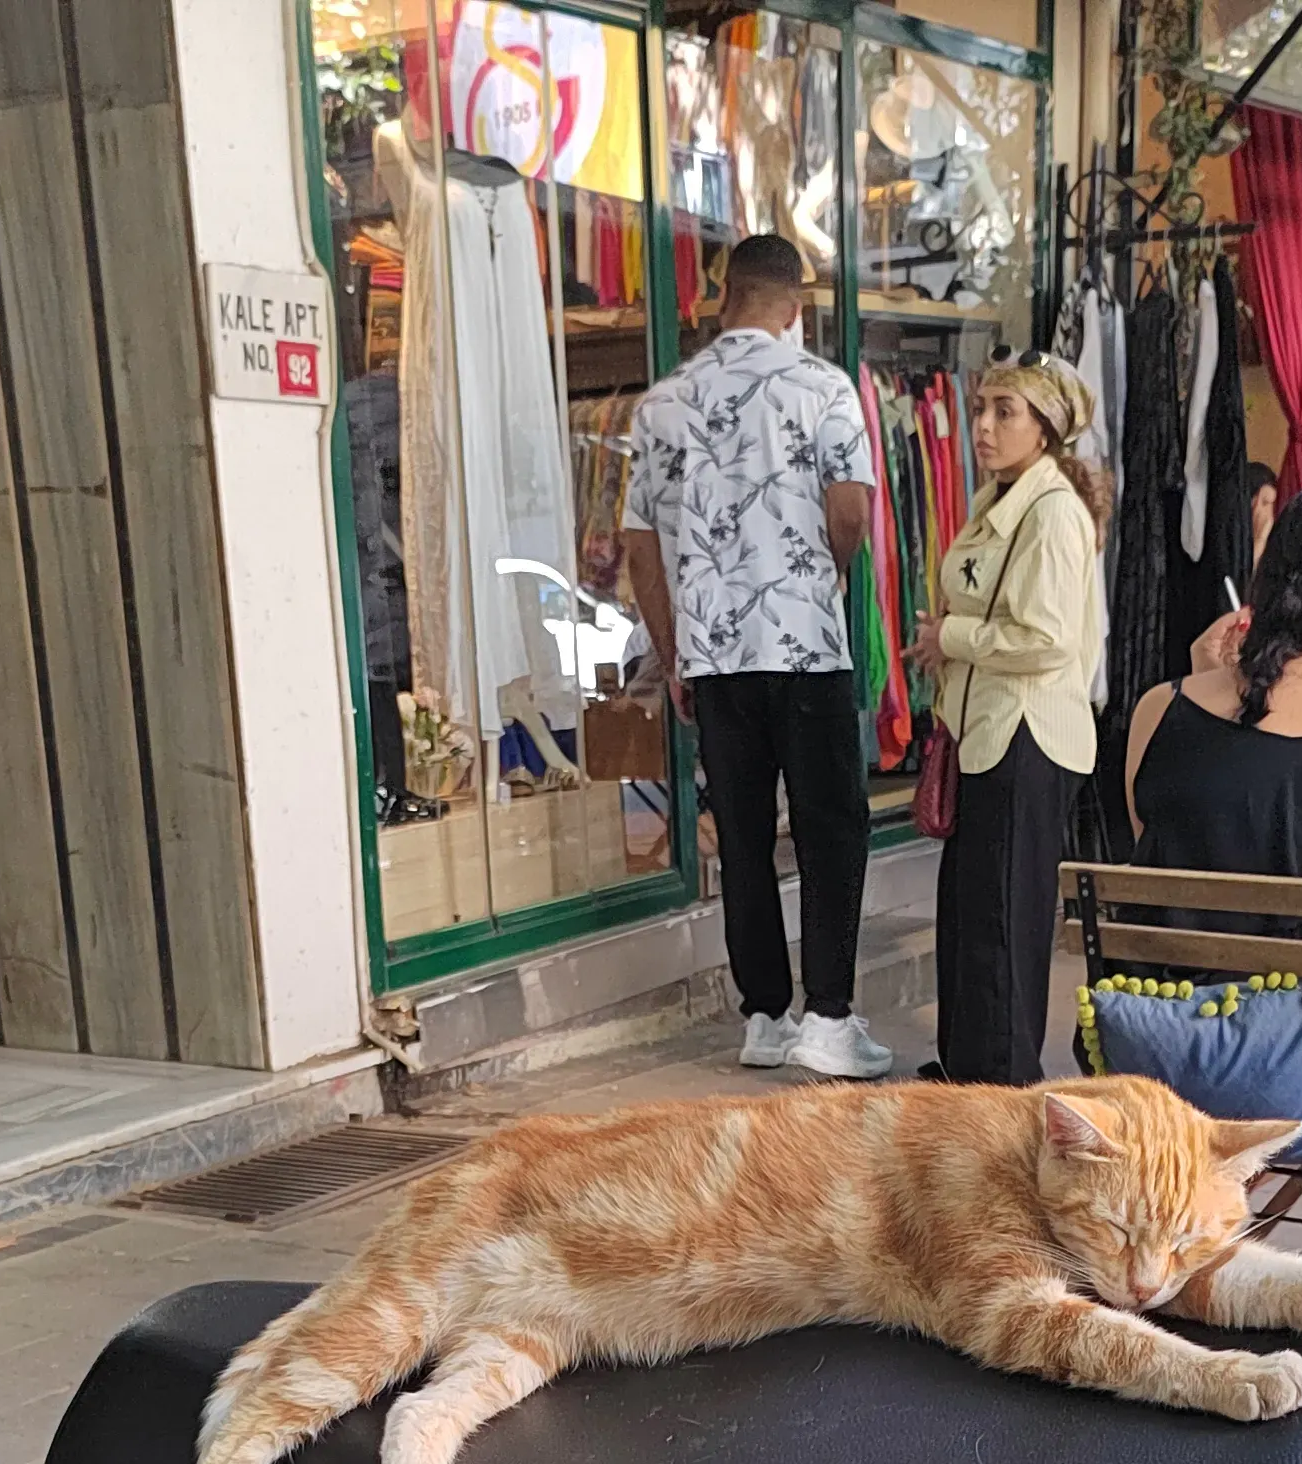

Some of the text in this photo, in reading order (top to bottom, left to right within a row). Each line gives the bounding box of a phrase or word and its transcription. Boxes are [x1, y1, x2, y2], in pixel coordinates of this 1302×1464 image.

[219, 292, 323, 340] KALE APT.
[288, 353, 313, 388] 92
